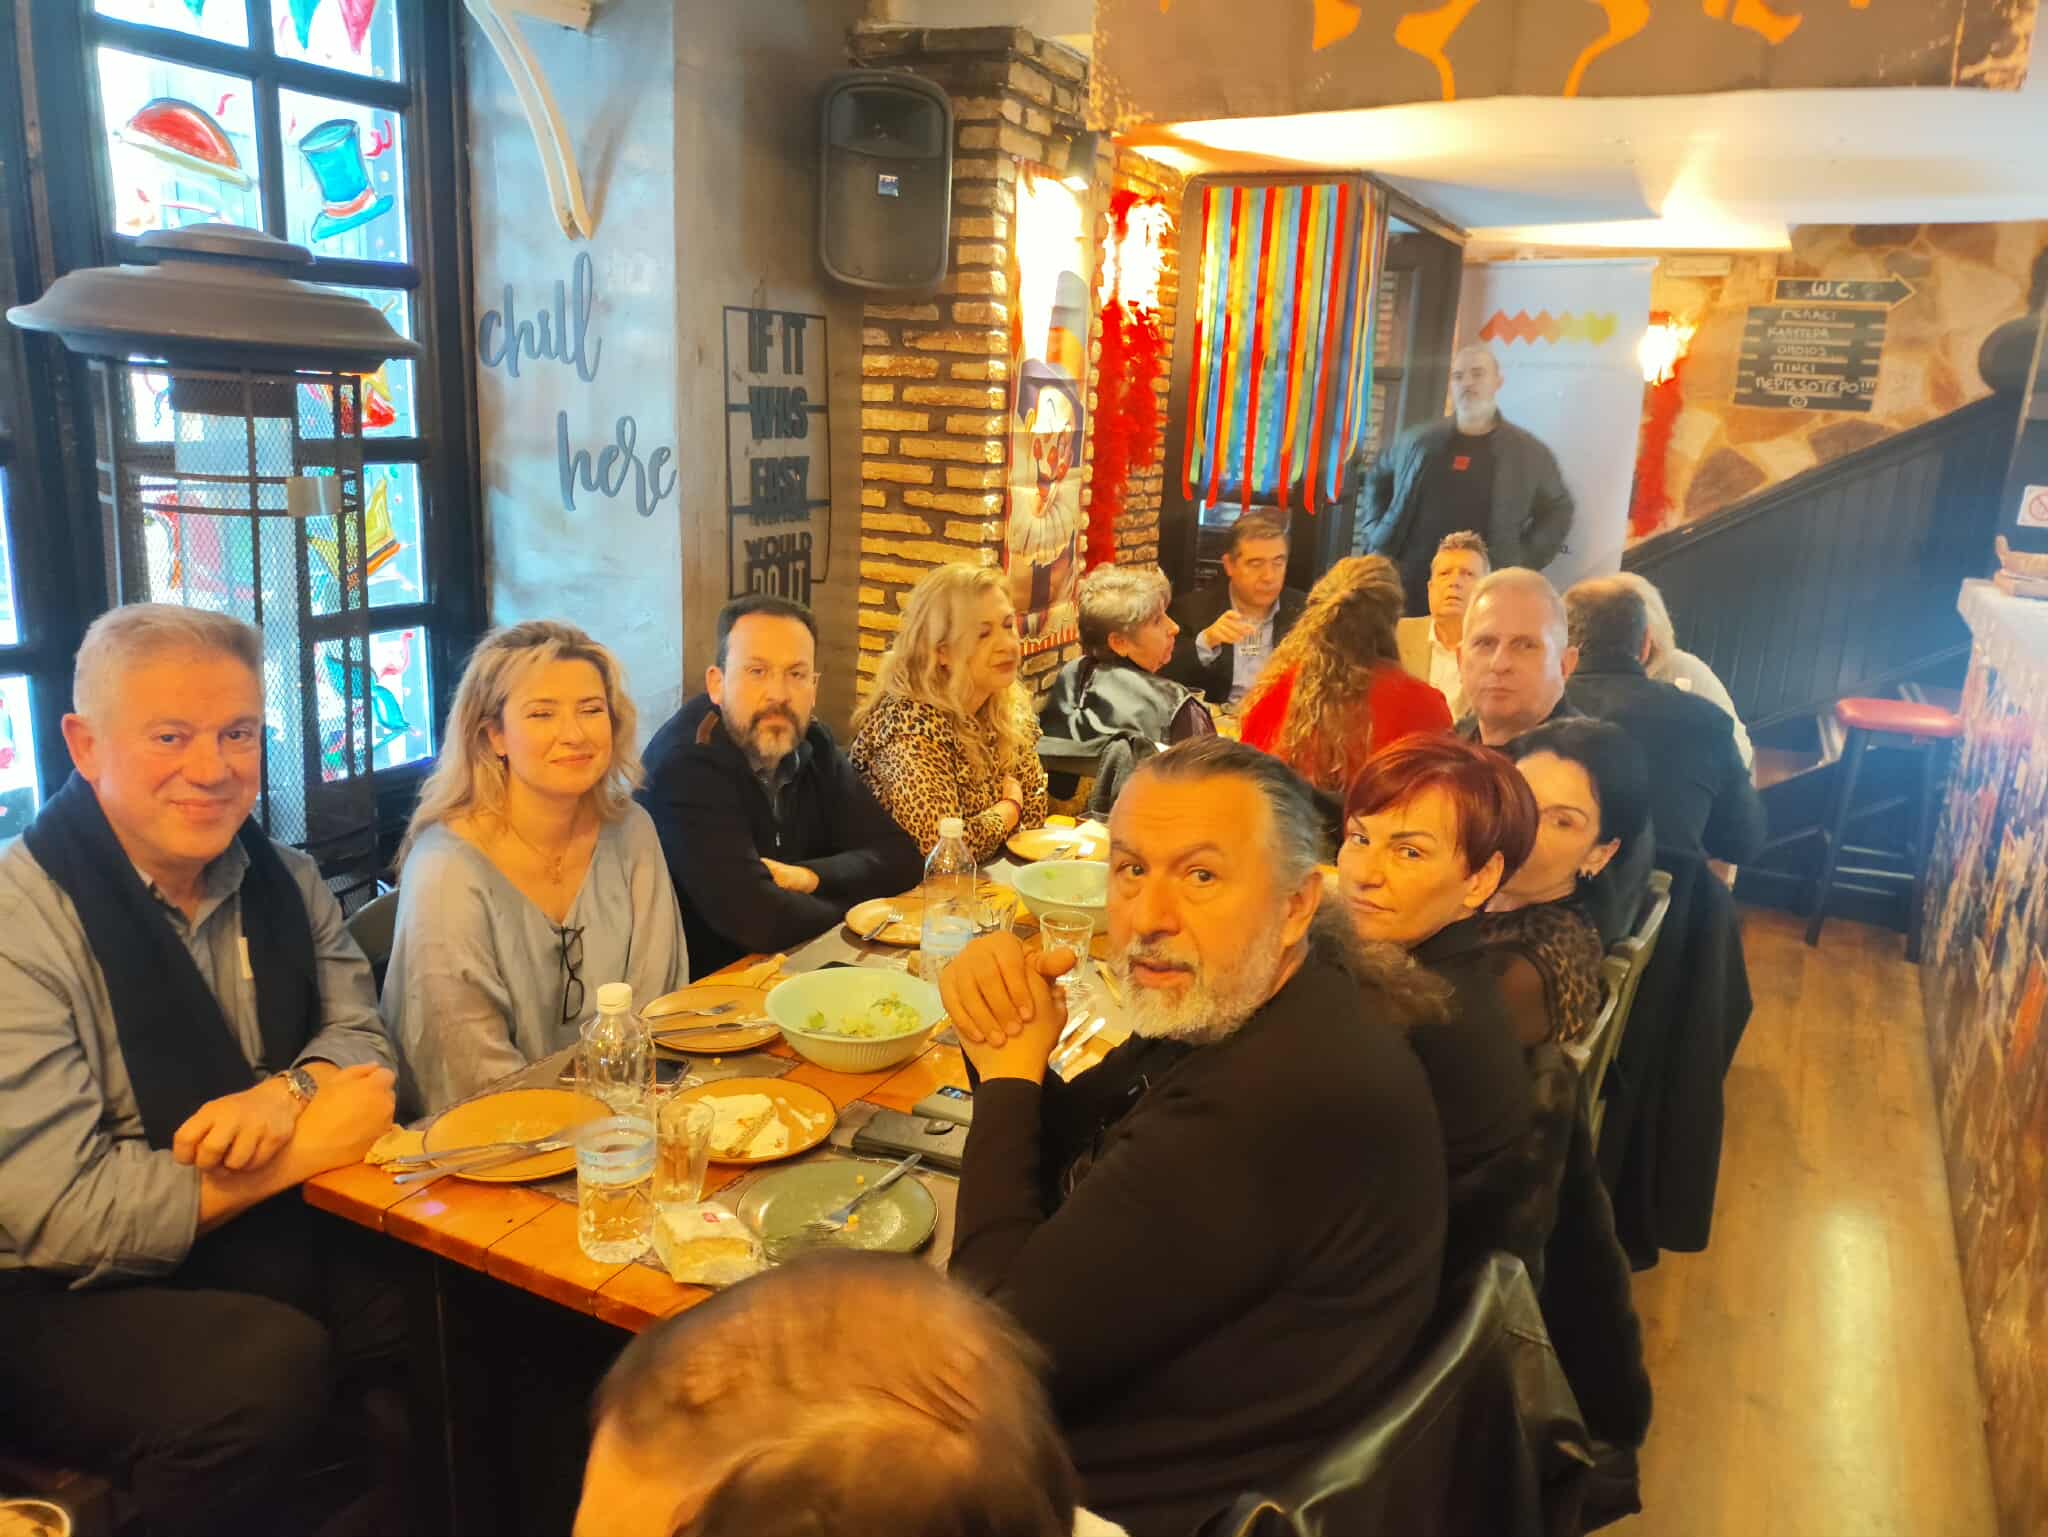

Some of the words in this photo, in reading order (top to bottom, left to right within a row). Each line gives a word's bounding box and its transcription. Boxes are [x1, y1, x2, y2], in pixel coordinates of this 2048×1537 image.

[479, 251, 602, 382] chill
[781, 311, 807, 375] IT
[557, 409, 677, 517] here
